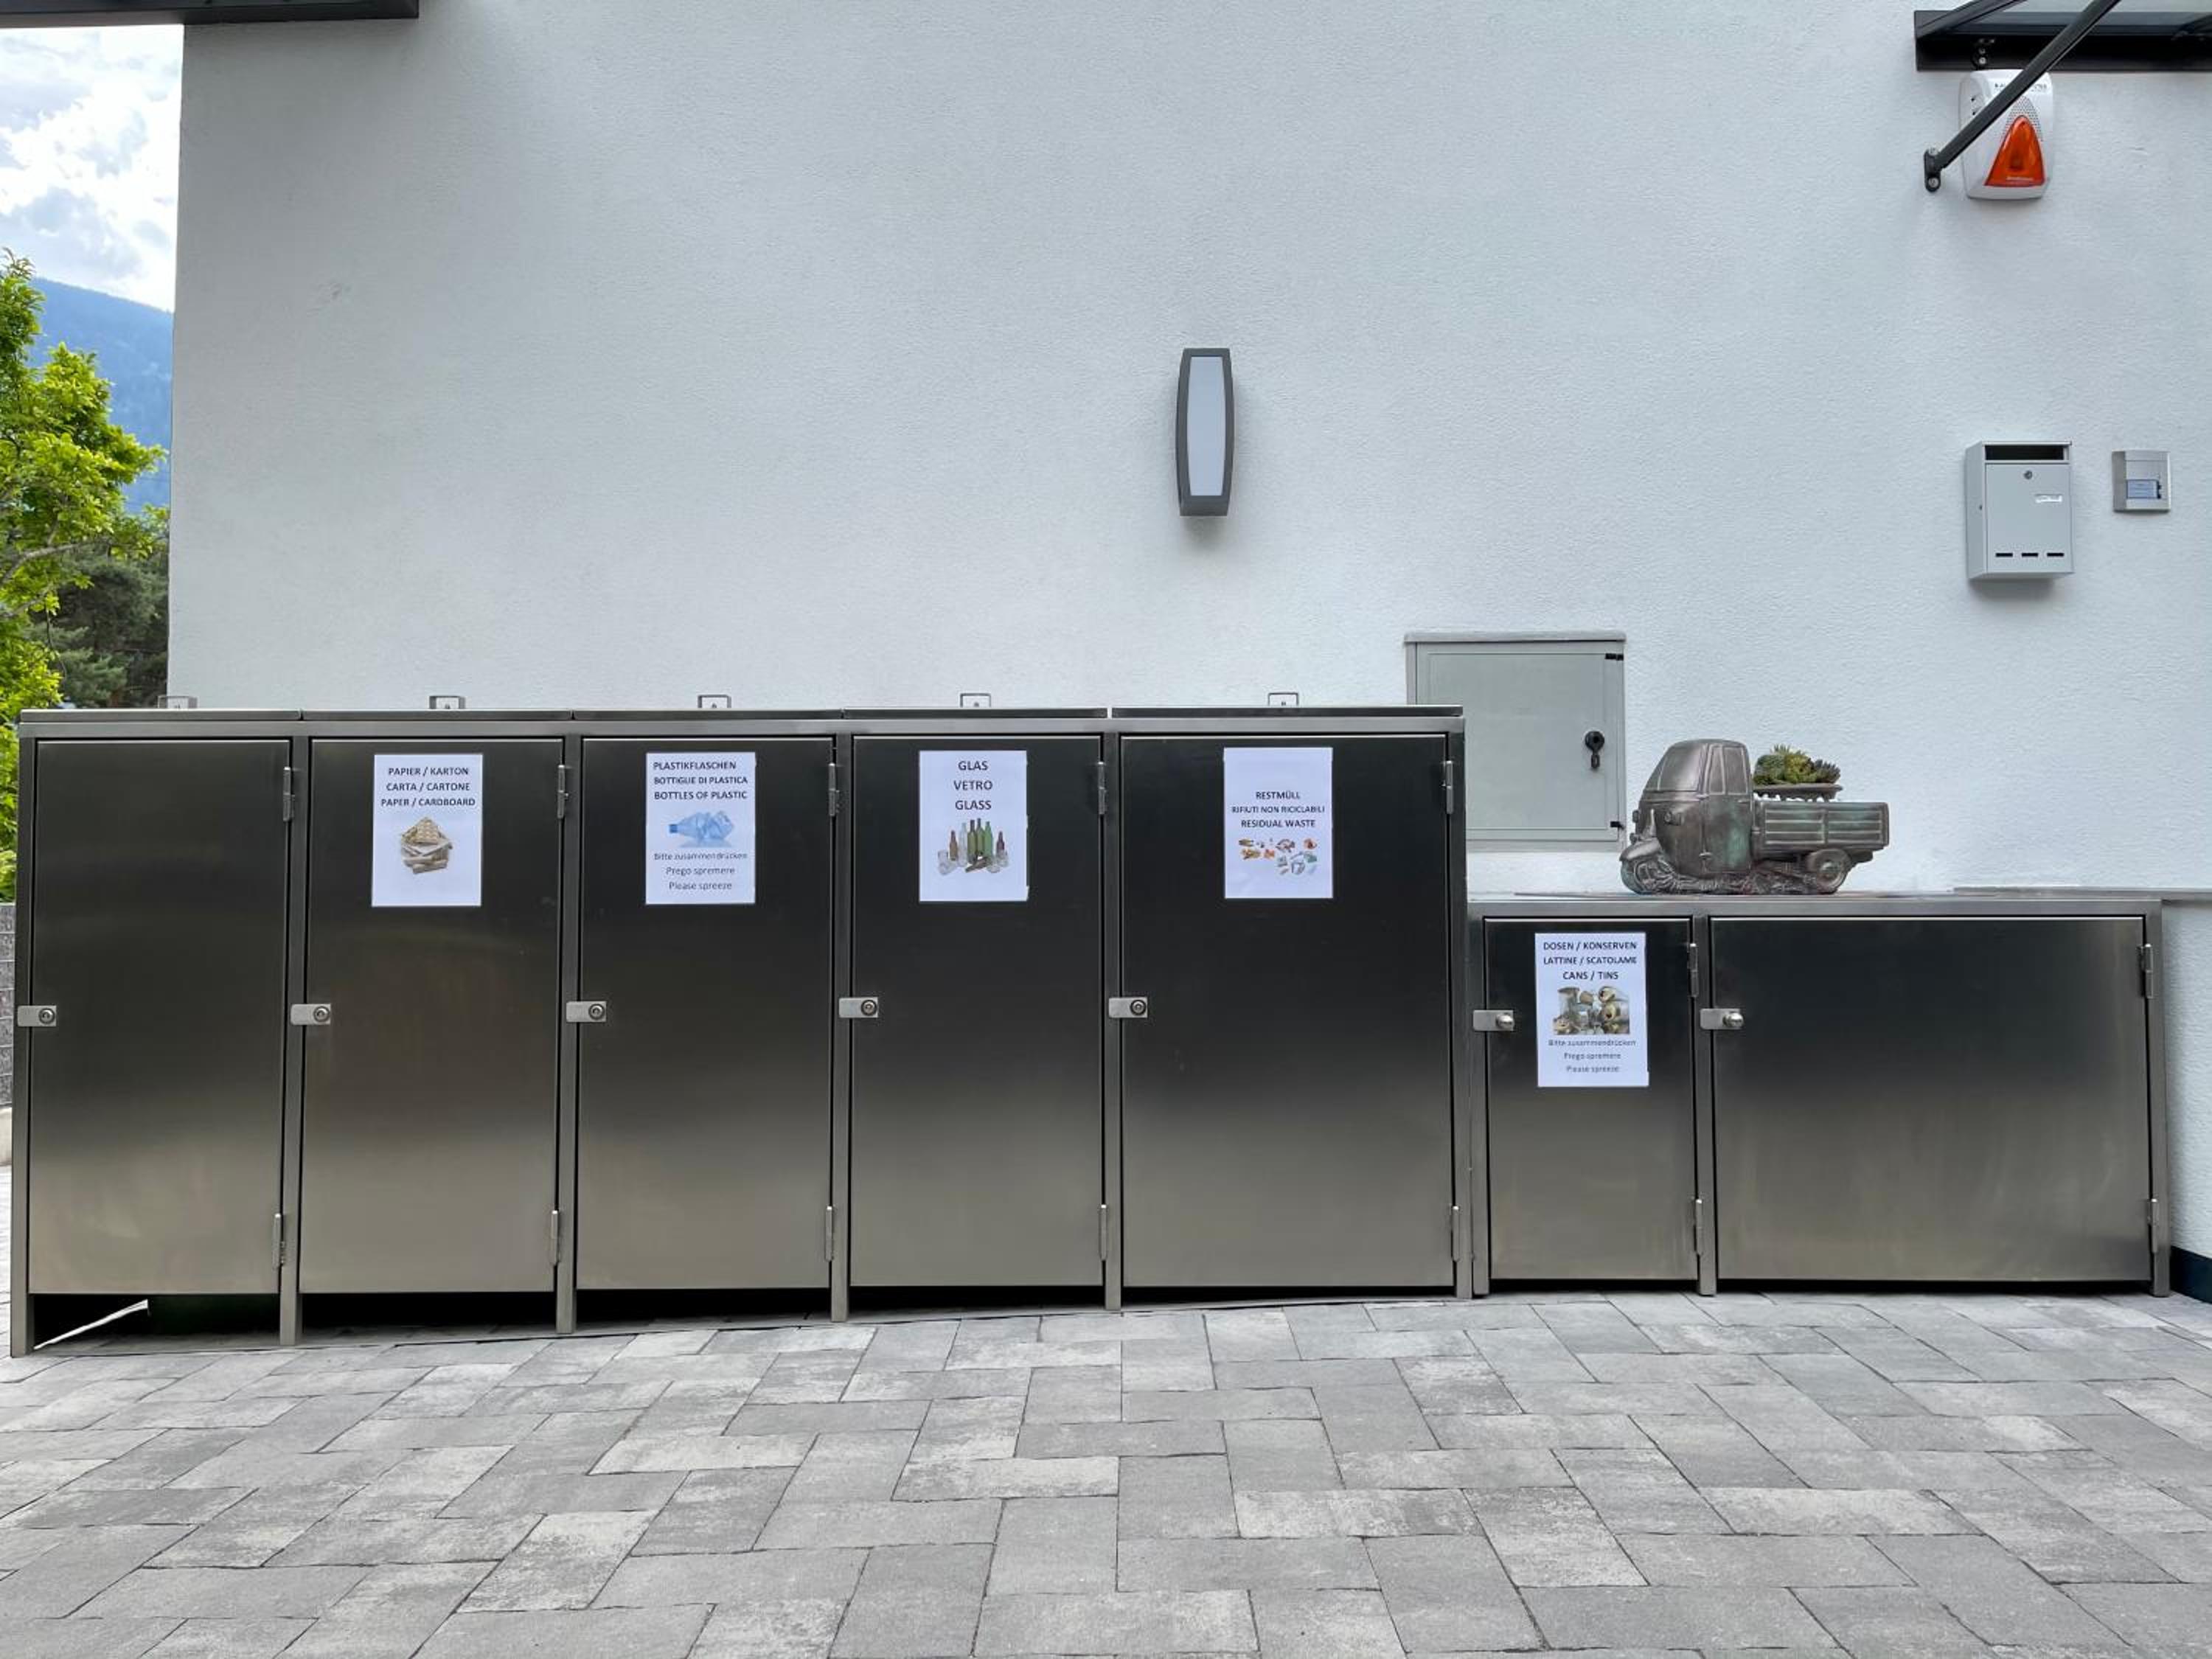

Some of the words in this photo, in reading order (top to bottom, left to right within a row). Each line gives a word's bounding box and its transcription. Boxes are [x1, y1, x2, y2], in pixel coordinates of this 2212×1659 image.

[653, 762, 736, 770] PLASTIKFLASCHEN
[958, 760, 988, 771] GLAS
[389, 768, 421, 776] PAPIER
[422, 767, 427, 776] /
[386, 783, 417, 791] CARTA
[419, 782, 424, 792] /
[953, 780, 993, 790] VETRO
[654, 791, 694, 799] BOTTLES
[696, 791, 708, 799] OF
[1256, 790, 1301, 799] RESTMÜLL
[955, 800, 992, 810] GLASS
[1241, 819, 1283, 827] RESIDUAL
[1284, 819, 1315, 827] WASTE
[666, 867, 692, 876] Prego
[1543, 942, 1573, 950] DOSEN
[1583, 942, 1638, 950] KONSERVEN
[1587, 956, 1637, 964] SCATOLAME
[1562, 972, 1588, 980] CANS
